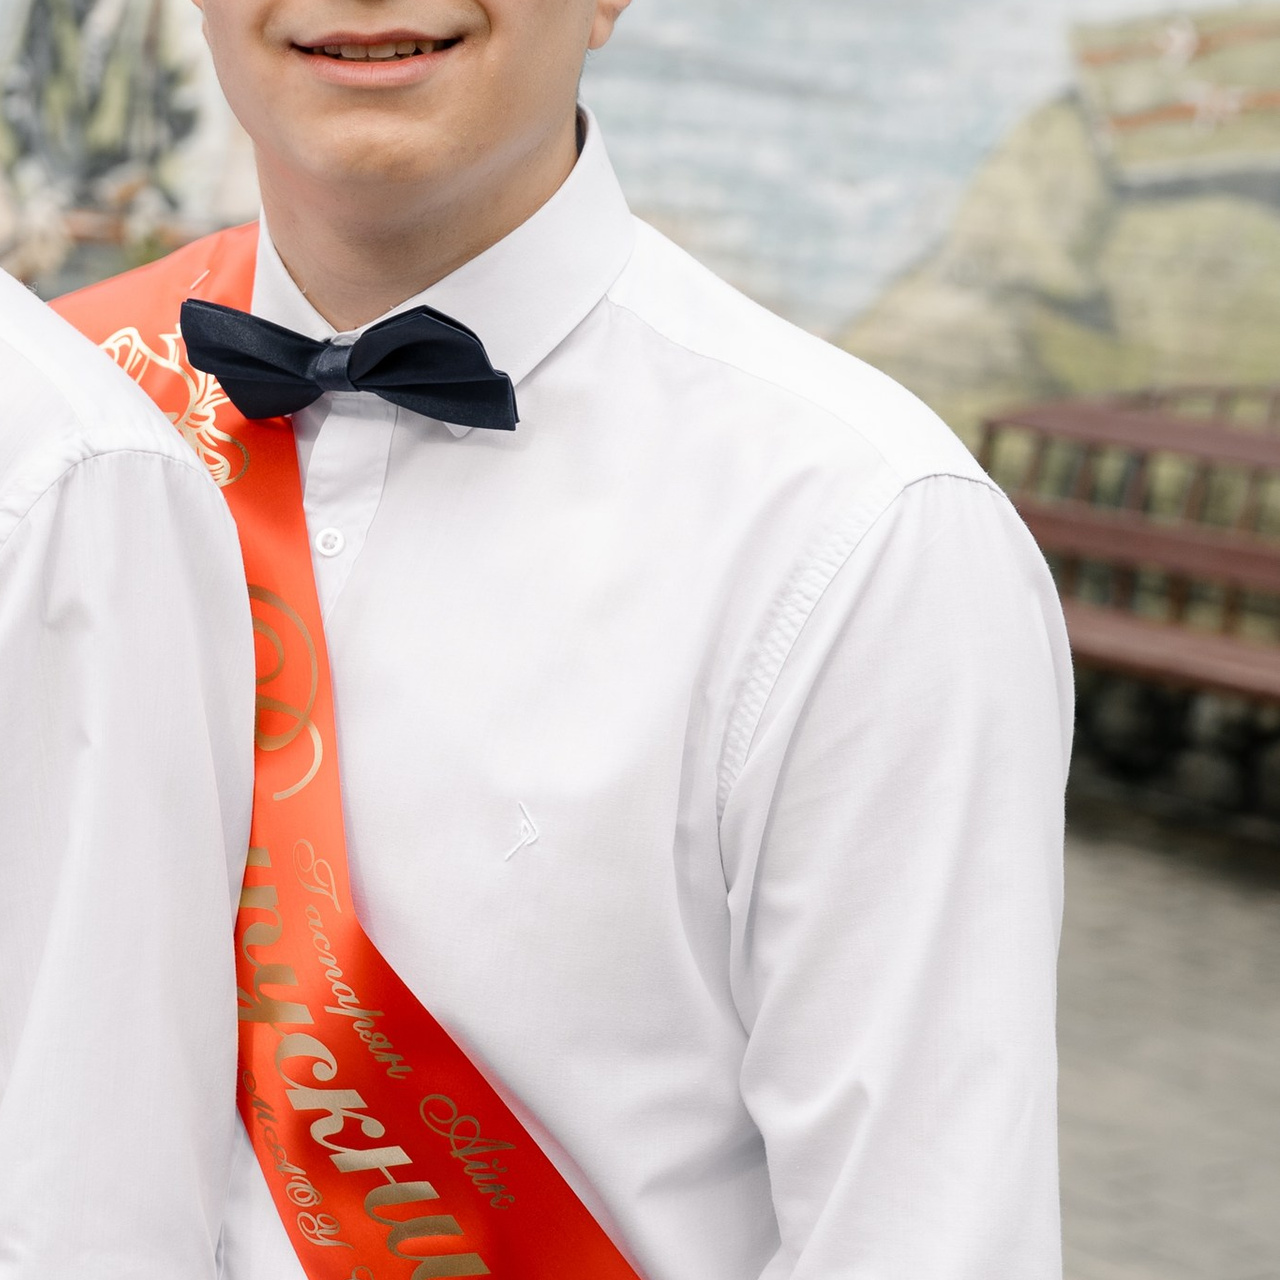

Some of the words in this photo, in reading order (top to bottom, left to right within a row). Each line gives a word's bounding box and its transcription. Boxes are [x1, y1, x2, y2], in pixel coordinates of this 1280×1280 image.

[242, 1070, 355, 1250] МАОУ
[291, 838, 413, 1080] Гаспарян
[419, 1093, 517, 1209] Айк
